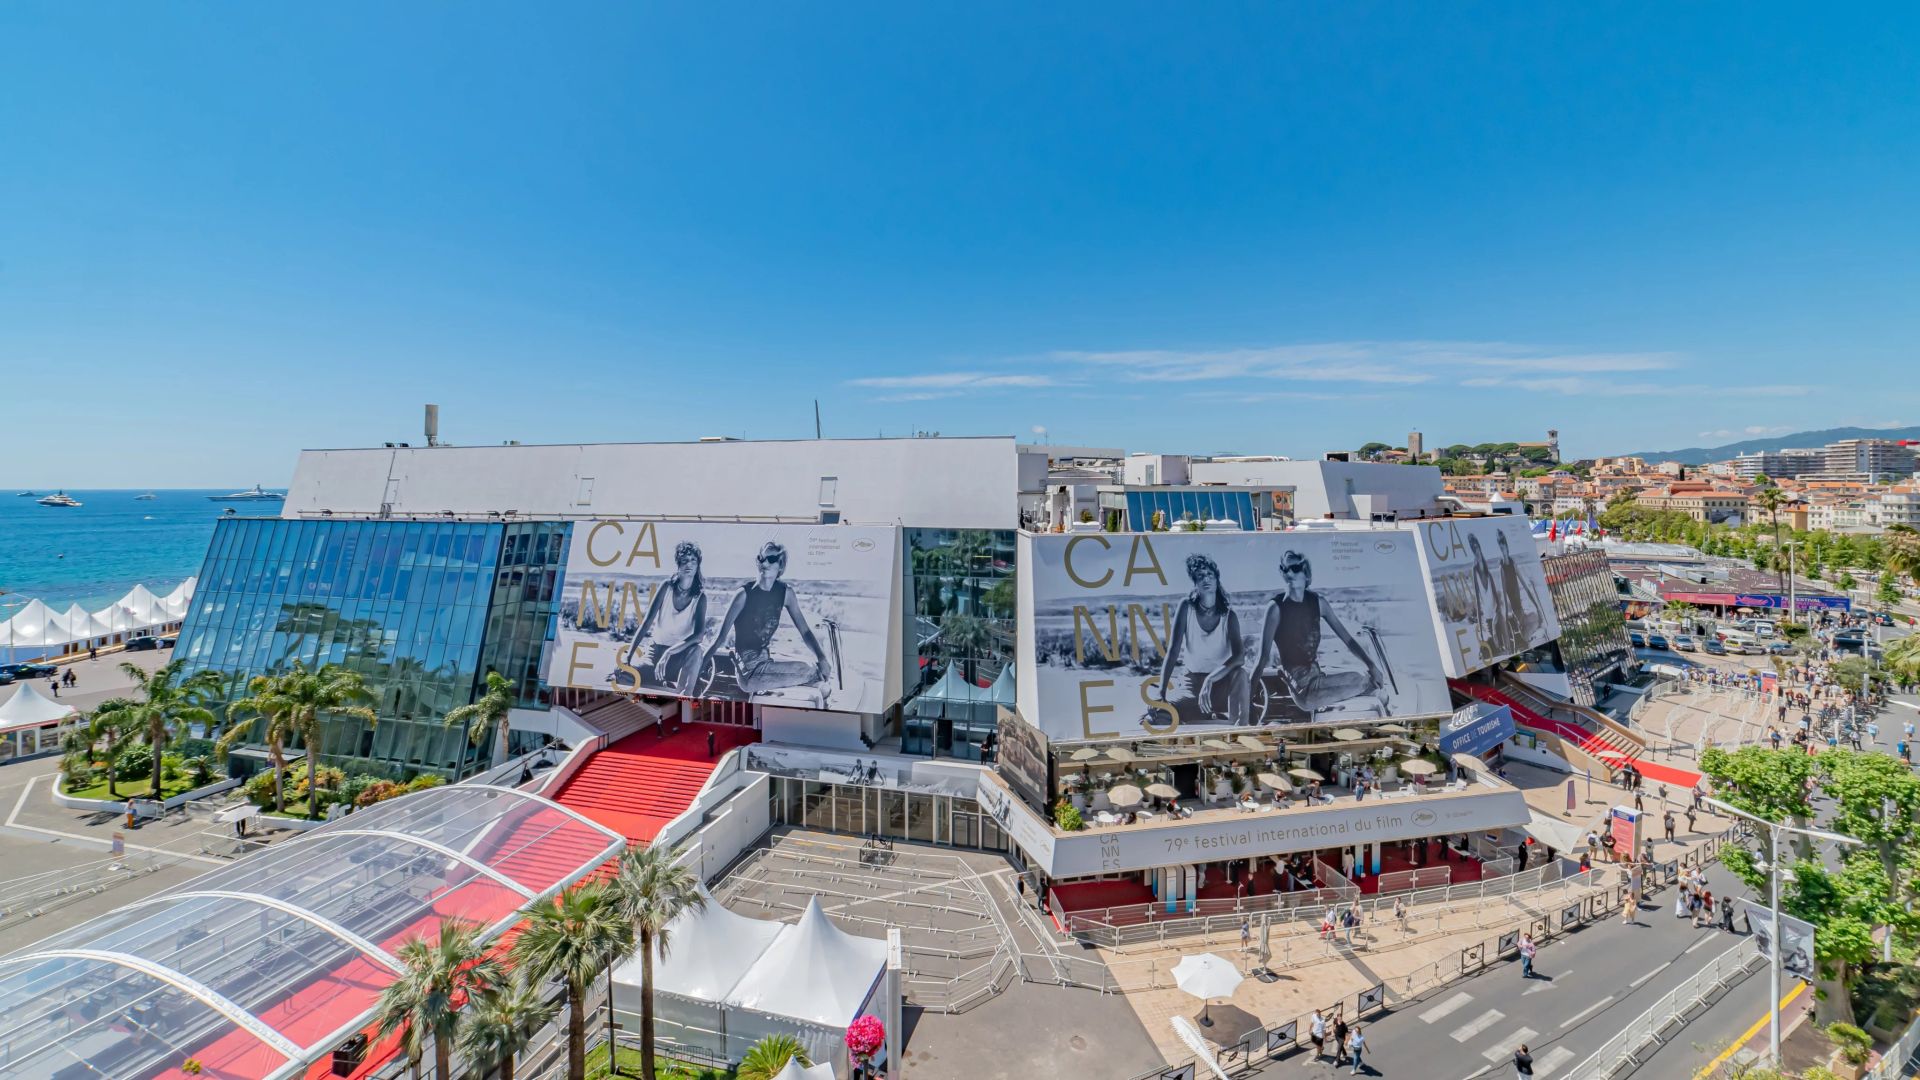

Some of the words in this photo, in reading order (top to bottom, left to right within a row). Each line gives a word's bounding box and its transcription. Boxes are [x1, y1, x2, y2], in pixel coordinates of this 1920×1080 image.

[586, 521, 661, 569] CA
[1064, 535, 1168, 588] CA
[1428, 521, 1468, 561] CA
[576, 579, 658, 630] NN
[1073, 602, 1171, 663] NN
[567, 641, 643, 692] ES
[1079, 675, 1180, 739] ES
[1452, 733, 1471, 749] OFFICE
[1477, 717, 1500, 736] TOURISME
[1100, 833, 1119, 844] CA
[1101, 845, 1120, 858] NN
[1195, 830, 1251, 849] festival
[1257, 817, 1350, 842] international
[1355, 815, 1372, 832] du
[1376, 814, 1402, 830] film
